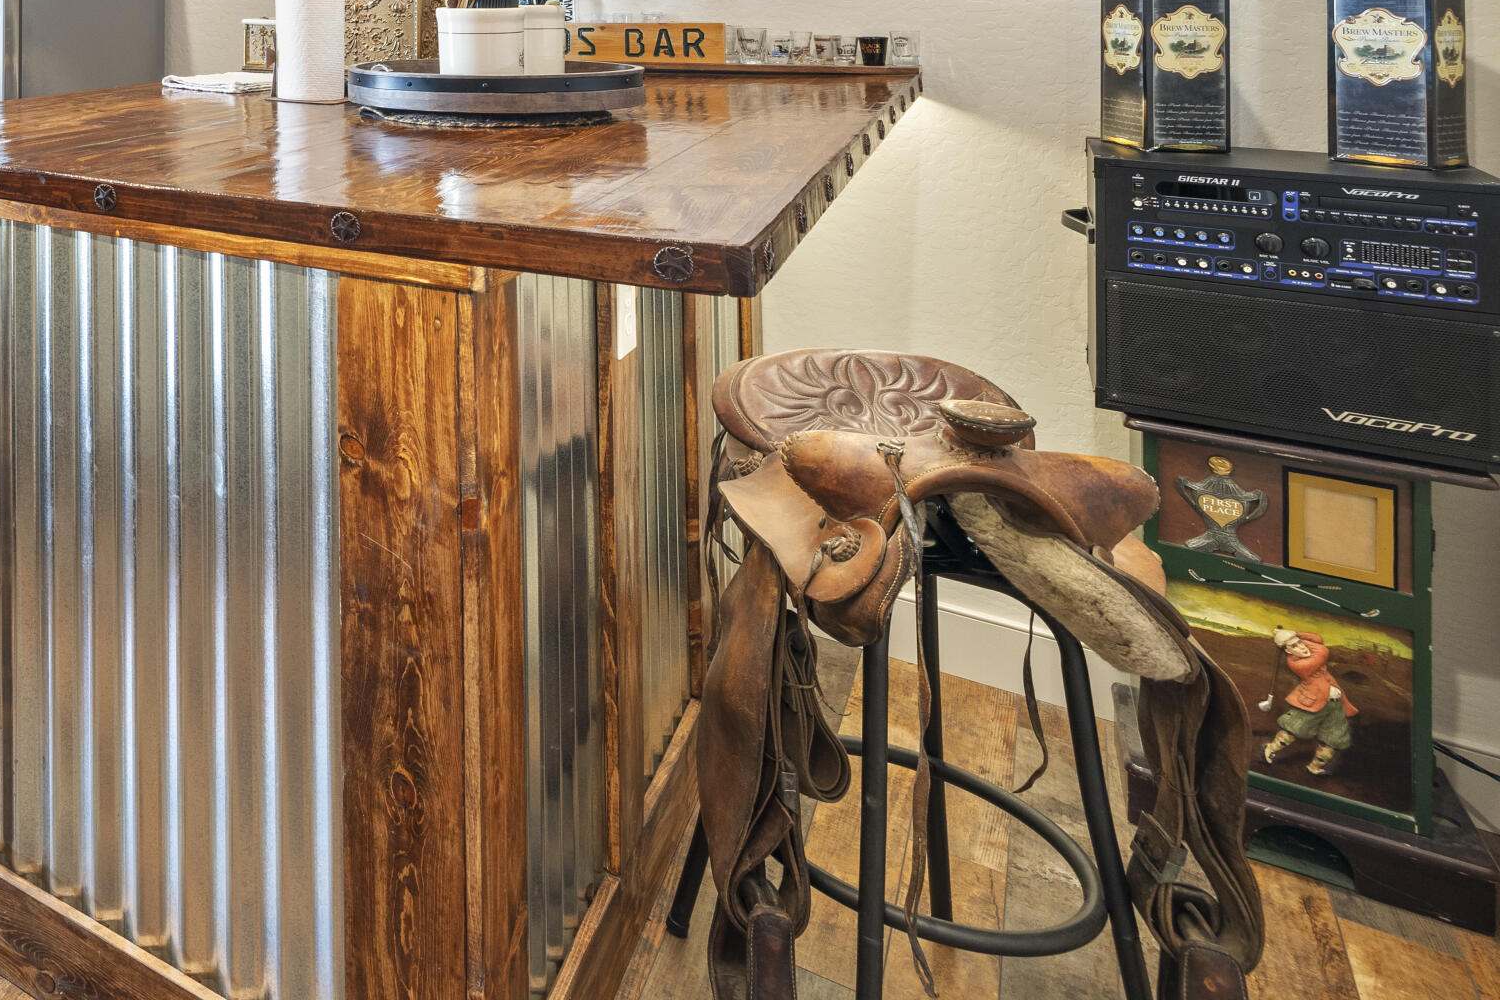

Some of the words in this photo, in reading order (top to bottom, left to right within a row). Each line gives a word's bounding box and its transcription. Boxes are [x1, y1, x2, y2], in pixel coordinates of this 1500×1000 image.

[1160, 23, 1183, 32] BREW
[1184, 23, 1220, 32] MASTERS
[1342, 26, 1371, 36] BREW
[1372, 27, 1419, 37] MASTERS
[624, 28, 706, 59] BAR
[1178, 175, 1229, 186] GIGSTAR
[1341, 187, 1420, 200] VocoPro
[1321, 407, 1477, 442] VocoPro
[1202, 496, 1240, 509] FIRST
[1203, 504, 1241, 517] PLACE
